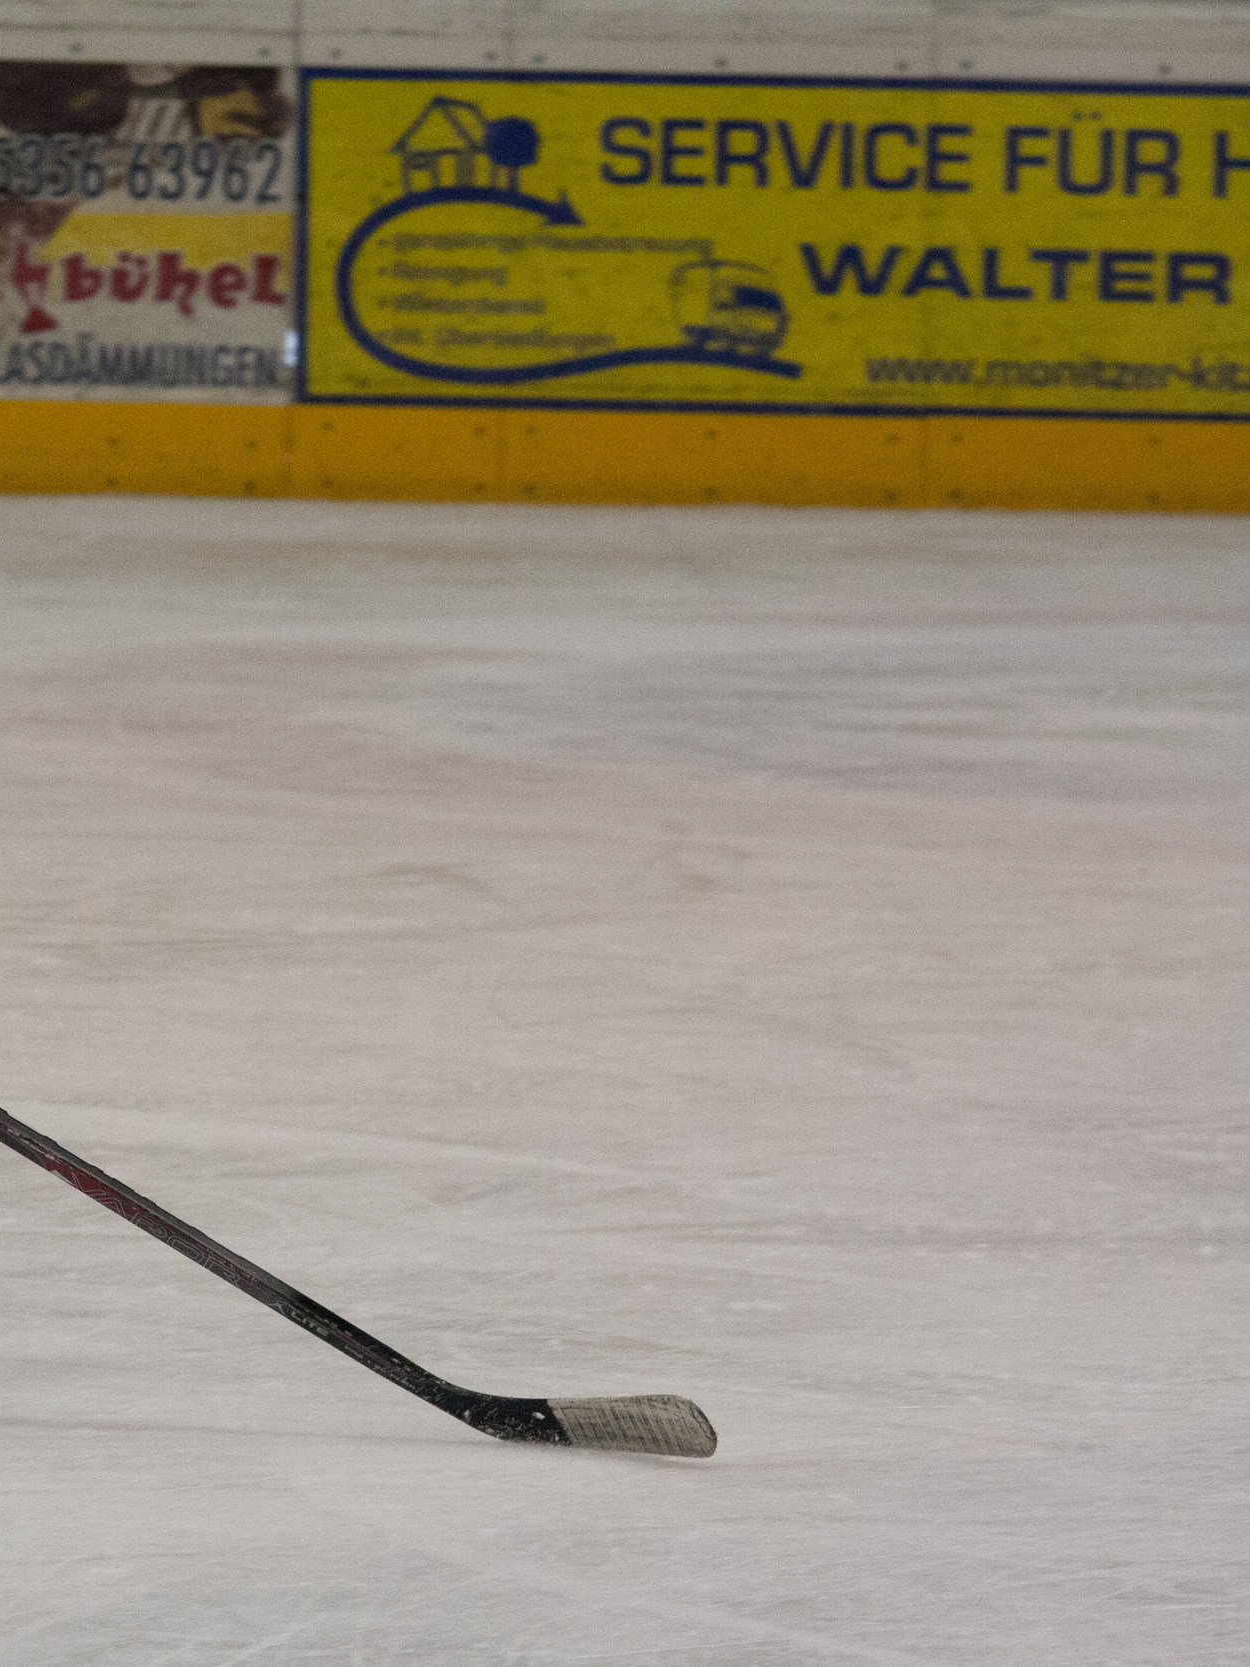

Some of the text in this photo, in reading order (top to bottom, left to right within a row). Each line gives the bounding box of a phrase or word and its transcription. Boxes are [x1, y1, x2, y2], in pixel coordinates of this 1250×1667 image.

[127, 140, 283, 202] 63962
[600, 115, 974, 193] SERVICE
[1003, 110, 1183, 198] FÜR
[798, 241, 1233, 306] WALTER
